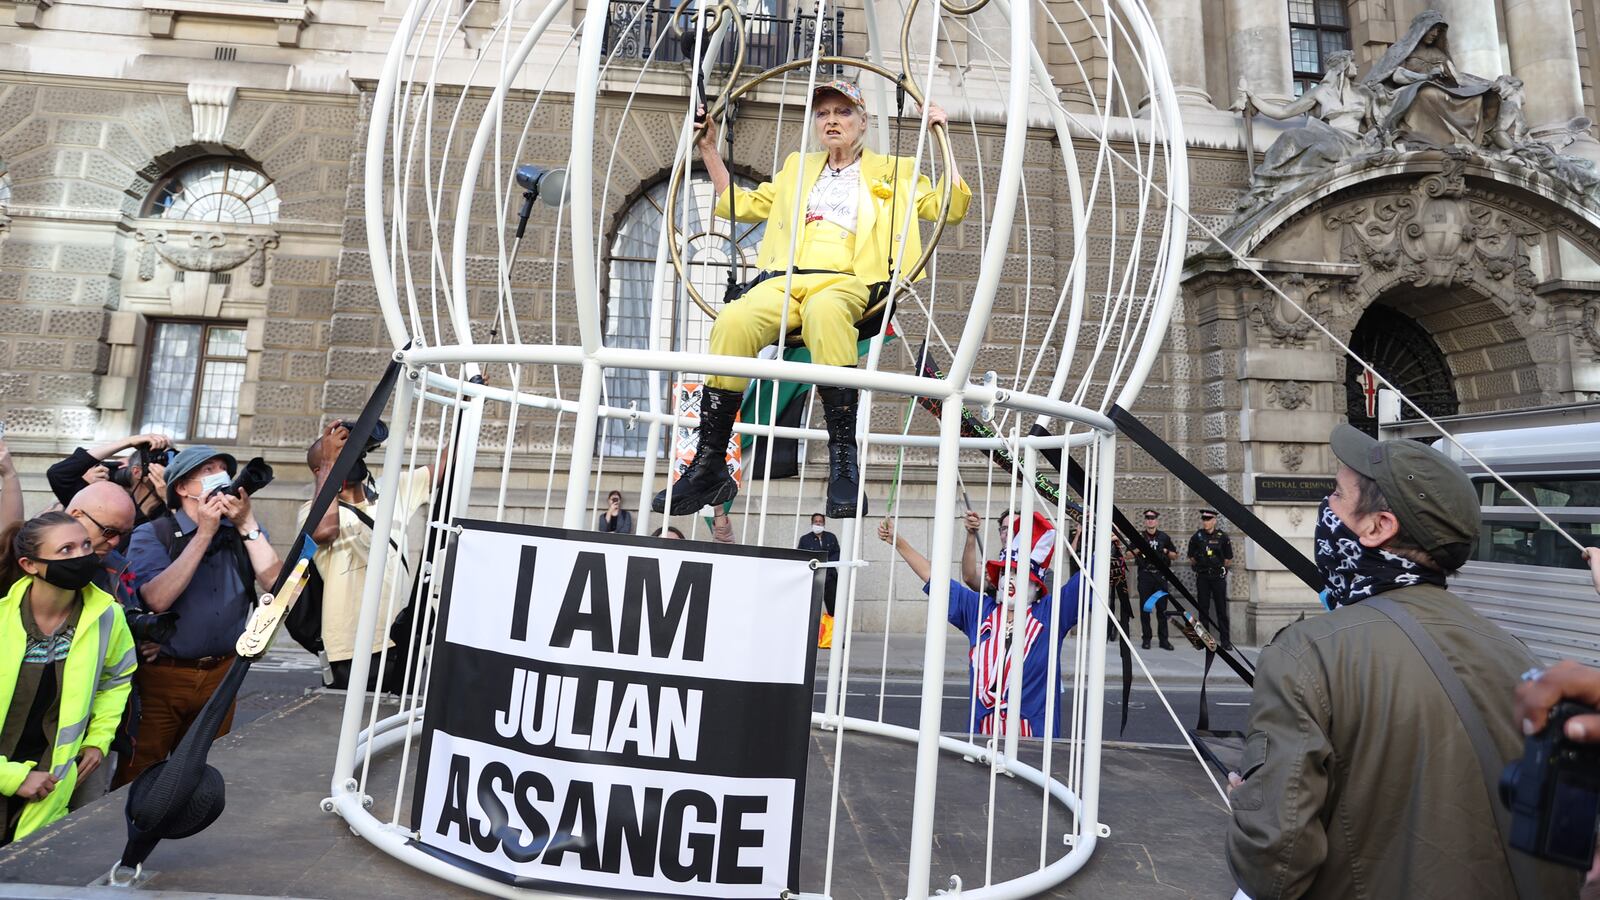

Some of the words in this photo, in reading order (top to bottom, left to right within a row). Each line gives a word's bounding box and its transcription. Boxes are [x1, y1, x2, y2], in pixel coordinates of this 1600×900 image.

[1262, 481, 1297, 489] CENTRAL
[510, 545, 537, 641] I
[549, 551, 713, 662] AM
[495, 668, 702, 761] JULIAN
[436, 754, 768, 885] ASSANGE
